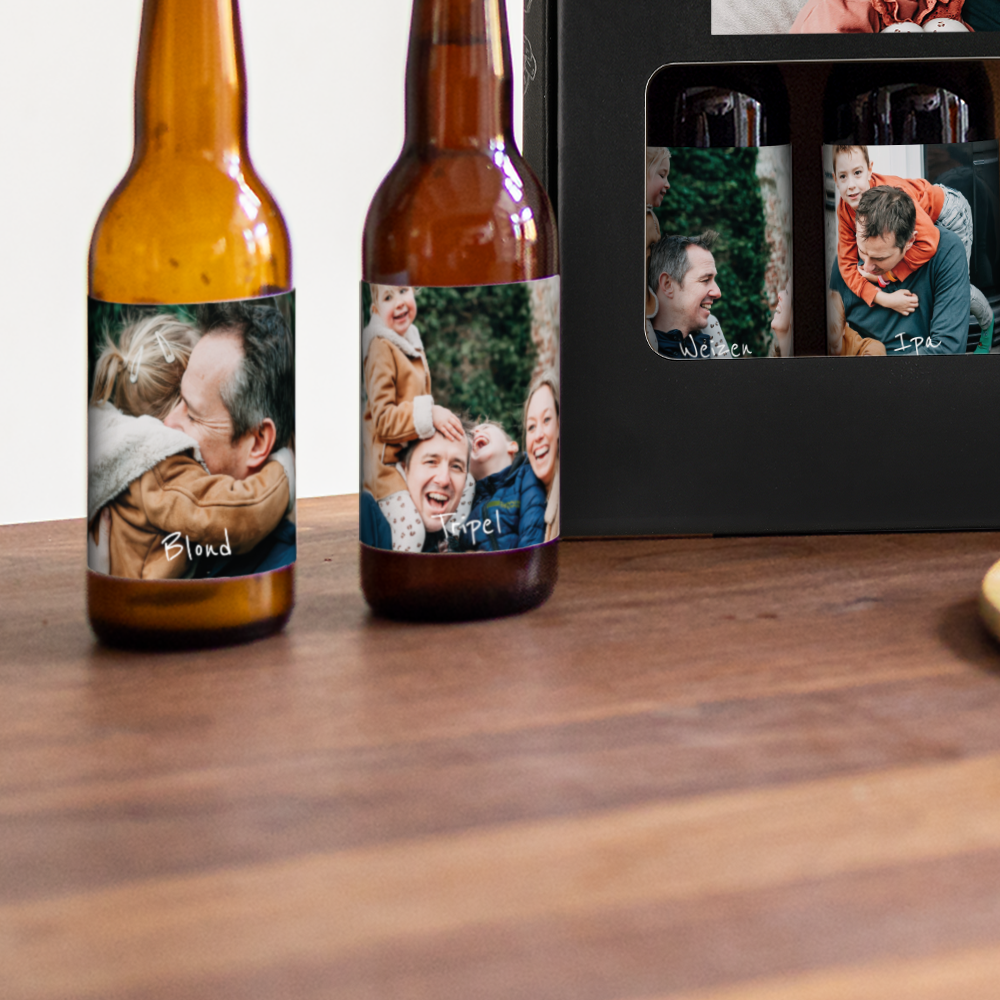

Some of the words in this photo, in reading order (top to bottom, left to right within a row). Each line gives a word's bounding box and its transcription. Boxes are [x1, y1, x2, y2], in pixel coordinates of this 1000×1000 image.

[679, 333, 753, 358] Weizen
[893, 331, 942, 356] Ipa
[431, 509, 502, 546] Tripel
[161, 528, 232, 562] Blond
